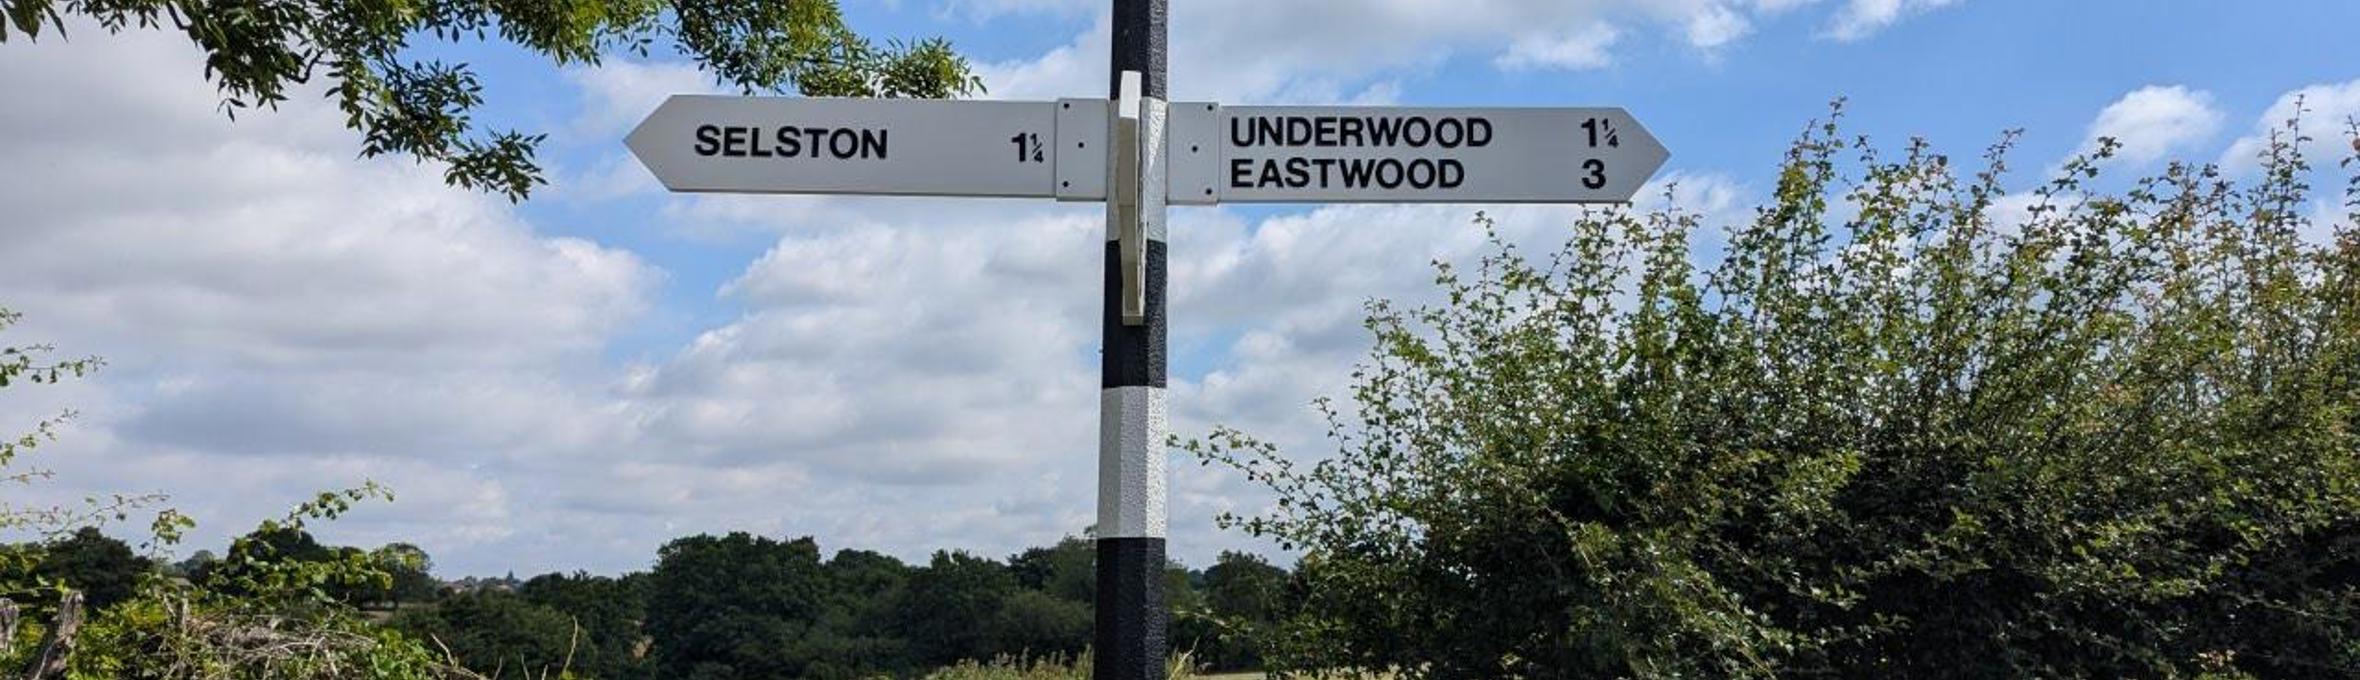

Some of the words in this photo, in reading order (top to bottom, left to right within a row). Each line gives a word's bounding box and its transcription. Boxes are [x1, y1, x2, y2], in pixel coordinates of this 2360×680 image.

[694, 124, 888, 160] SELSTON
[1230, 116, 1493, 149] UNDERWOOD
[1230, 156, 1465, 190] EASTWOOD
[1581, 158, 1607, 190] 3
